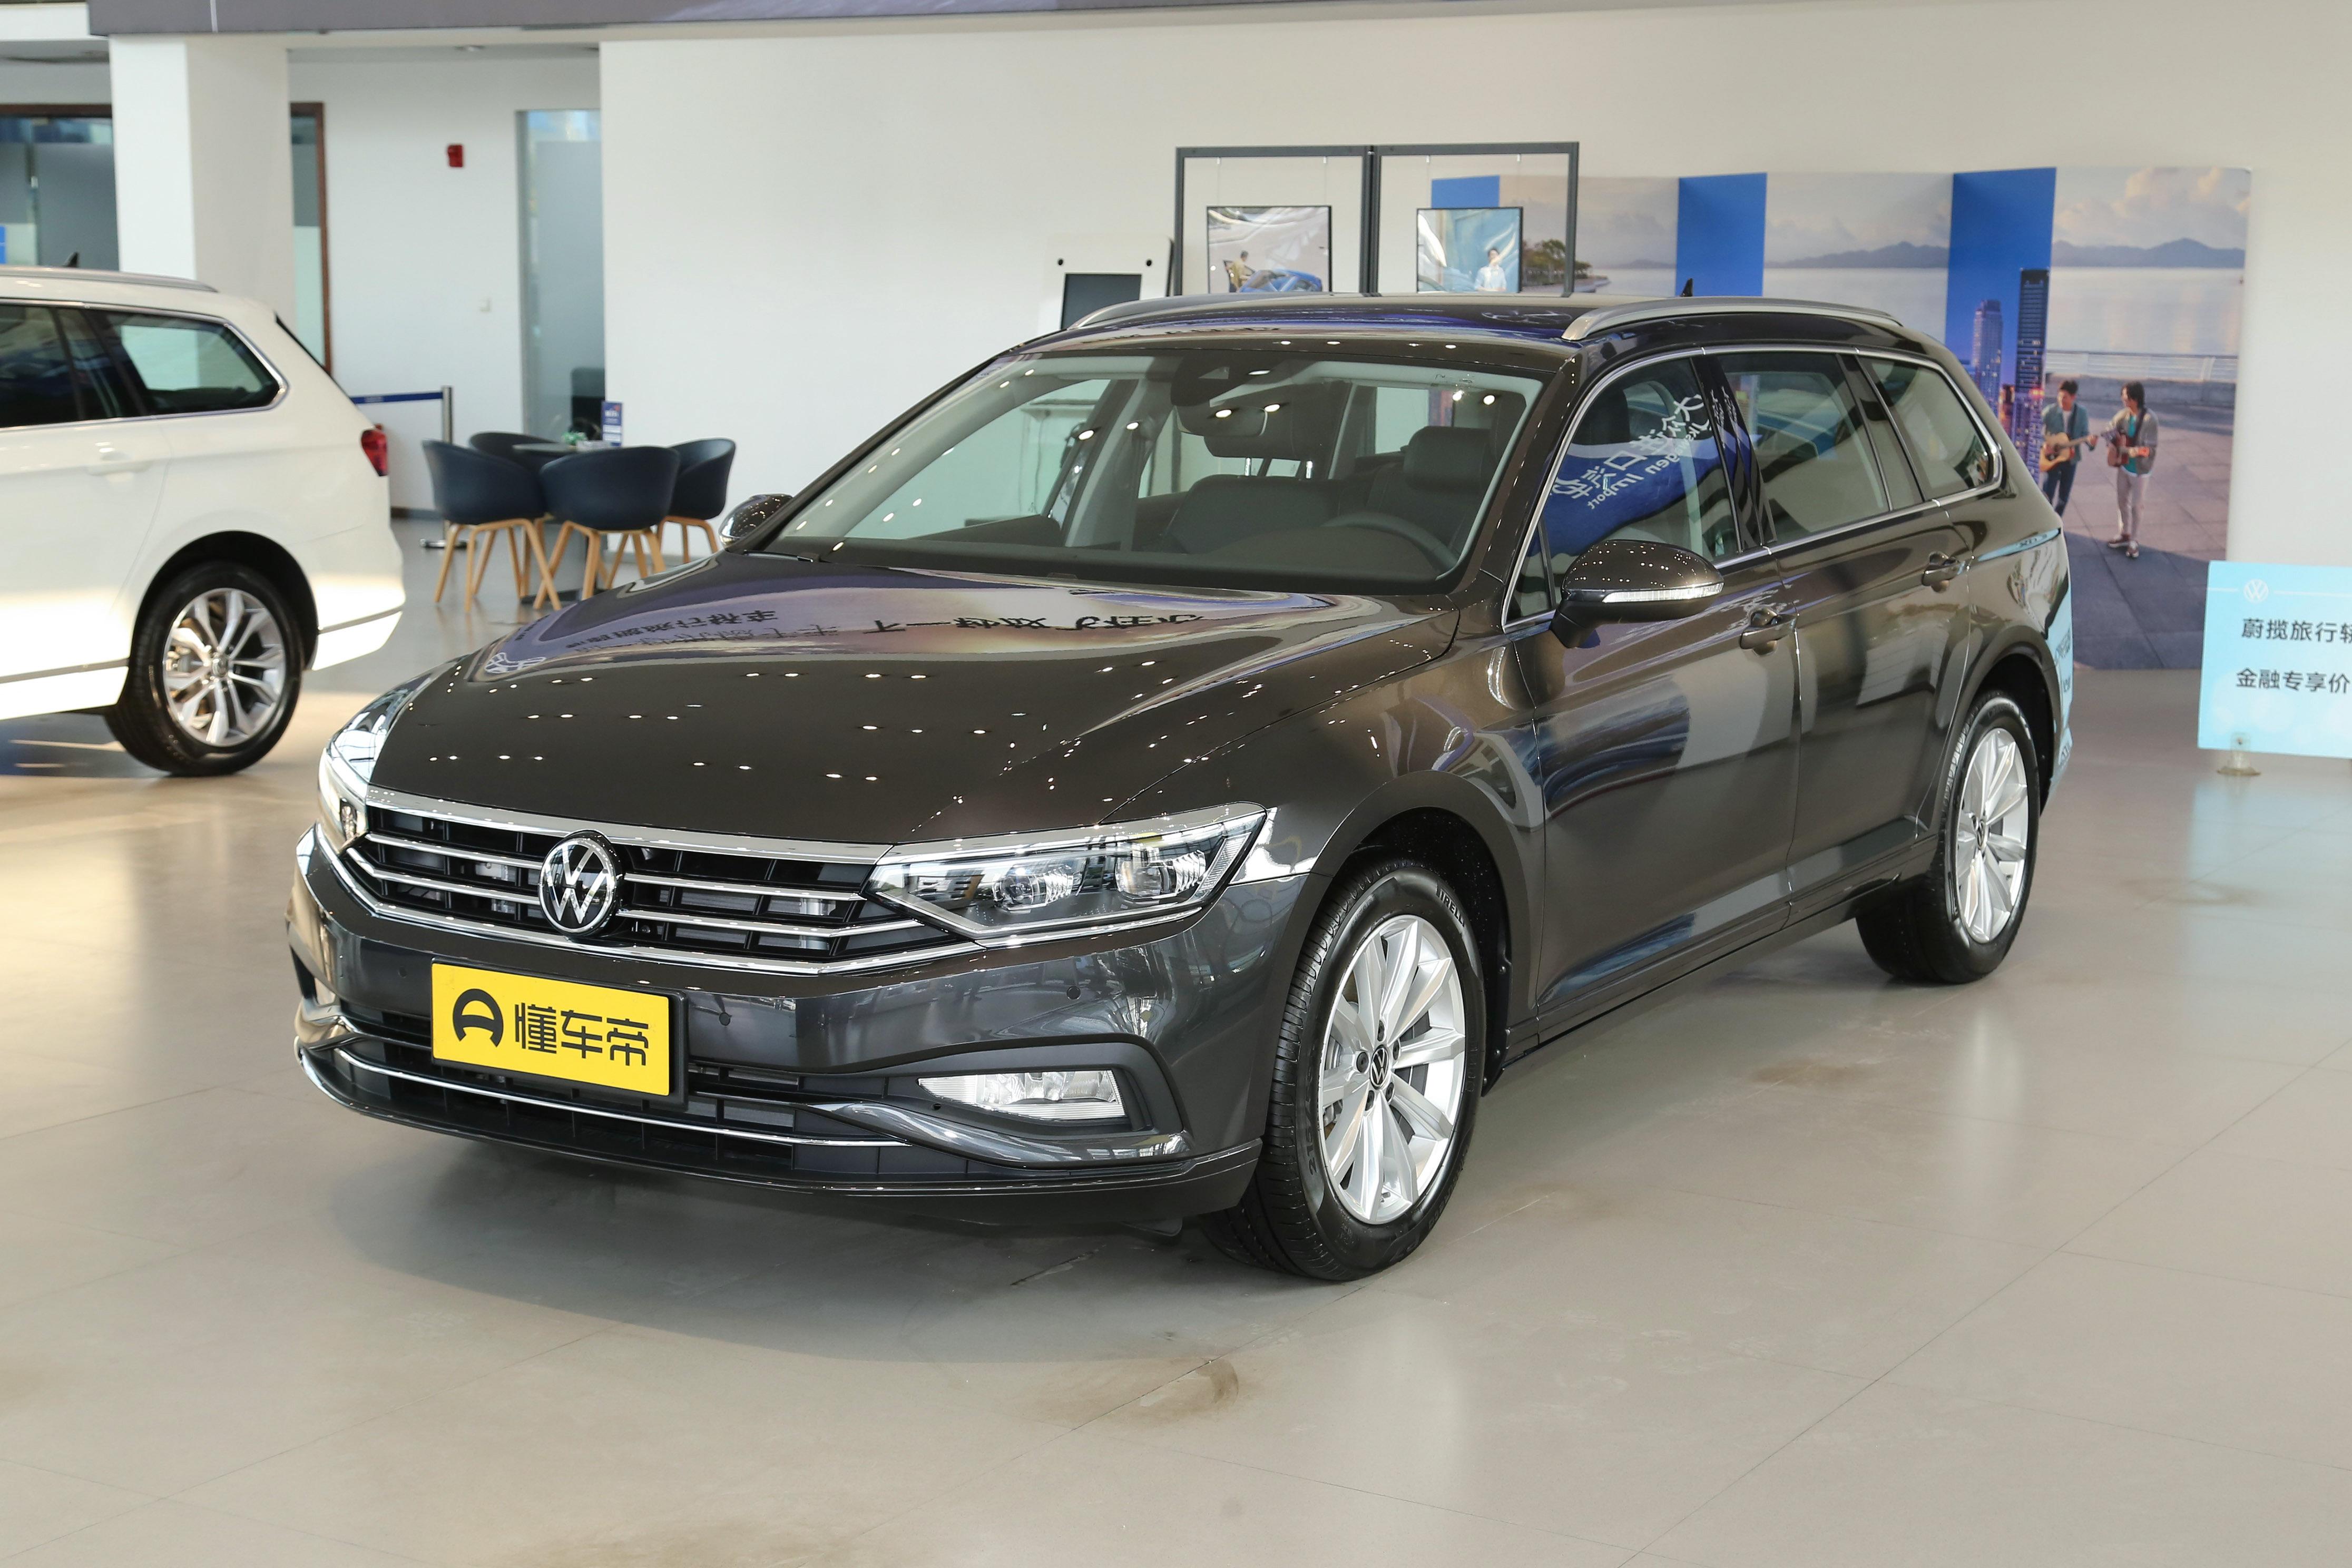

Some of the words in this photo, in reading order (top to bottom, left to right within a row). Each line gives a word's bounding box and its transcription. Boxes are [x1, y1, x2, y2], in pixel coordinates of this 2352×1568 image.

[2236, 668, 2350, 694] 金融专享价
[514, 1002, 649, 1066] 懂车帝
